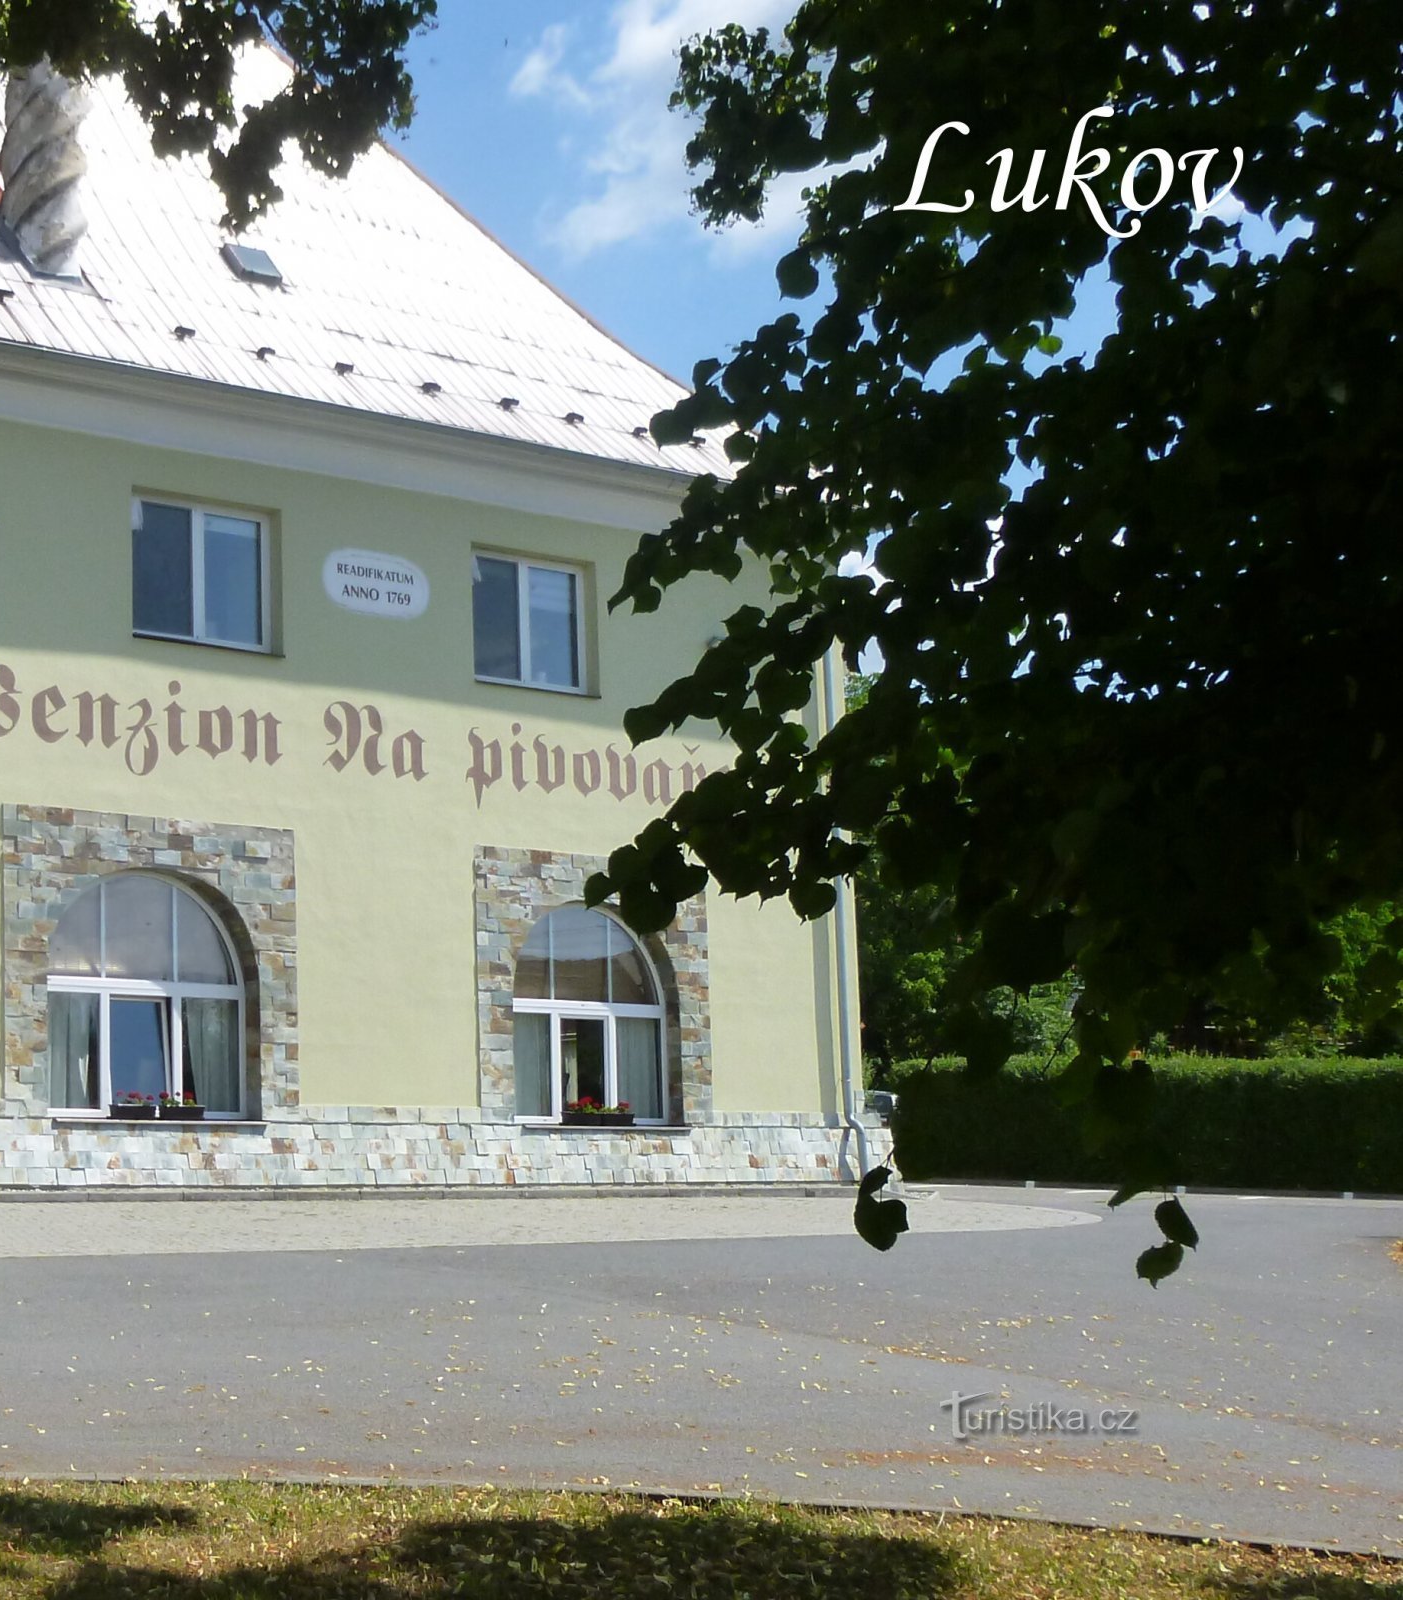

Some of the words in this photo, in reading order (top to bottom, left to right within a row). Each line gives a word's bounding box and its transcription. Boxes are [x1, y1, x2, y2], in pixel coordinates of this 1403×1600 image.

[337, 563, 414, 585] READIFIKATUM
[342, 584, 380, 601] ANNO
[386, 591, 411, 606] 1769
[323, 701, 429, 782] Na
[465, 722, 730, 810] pivovař
